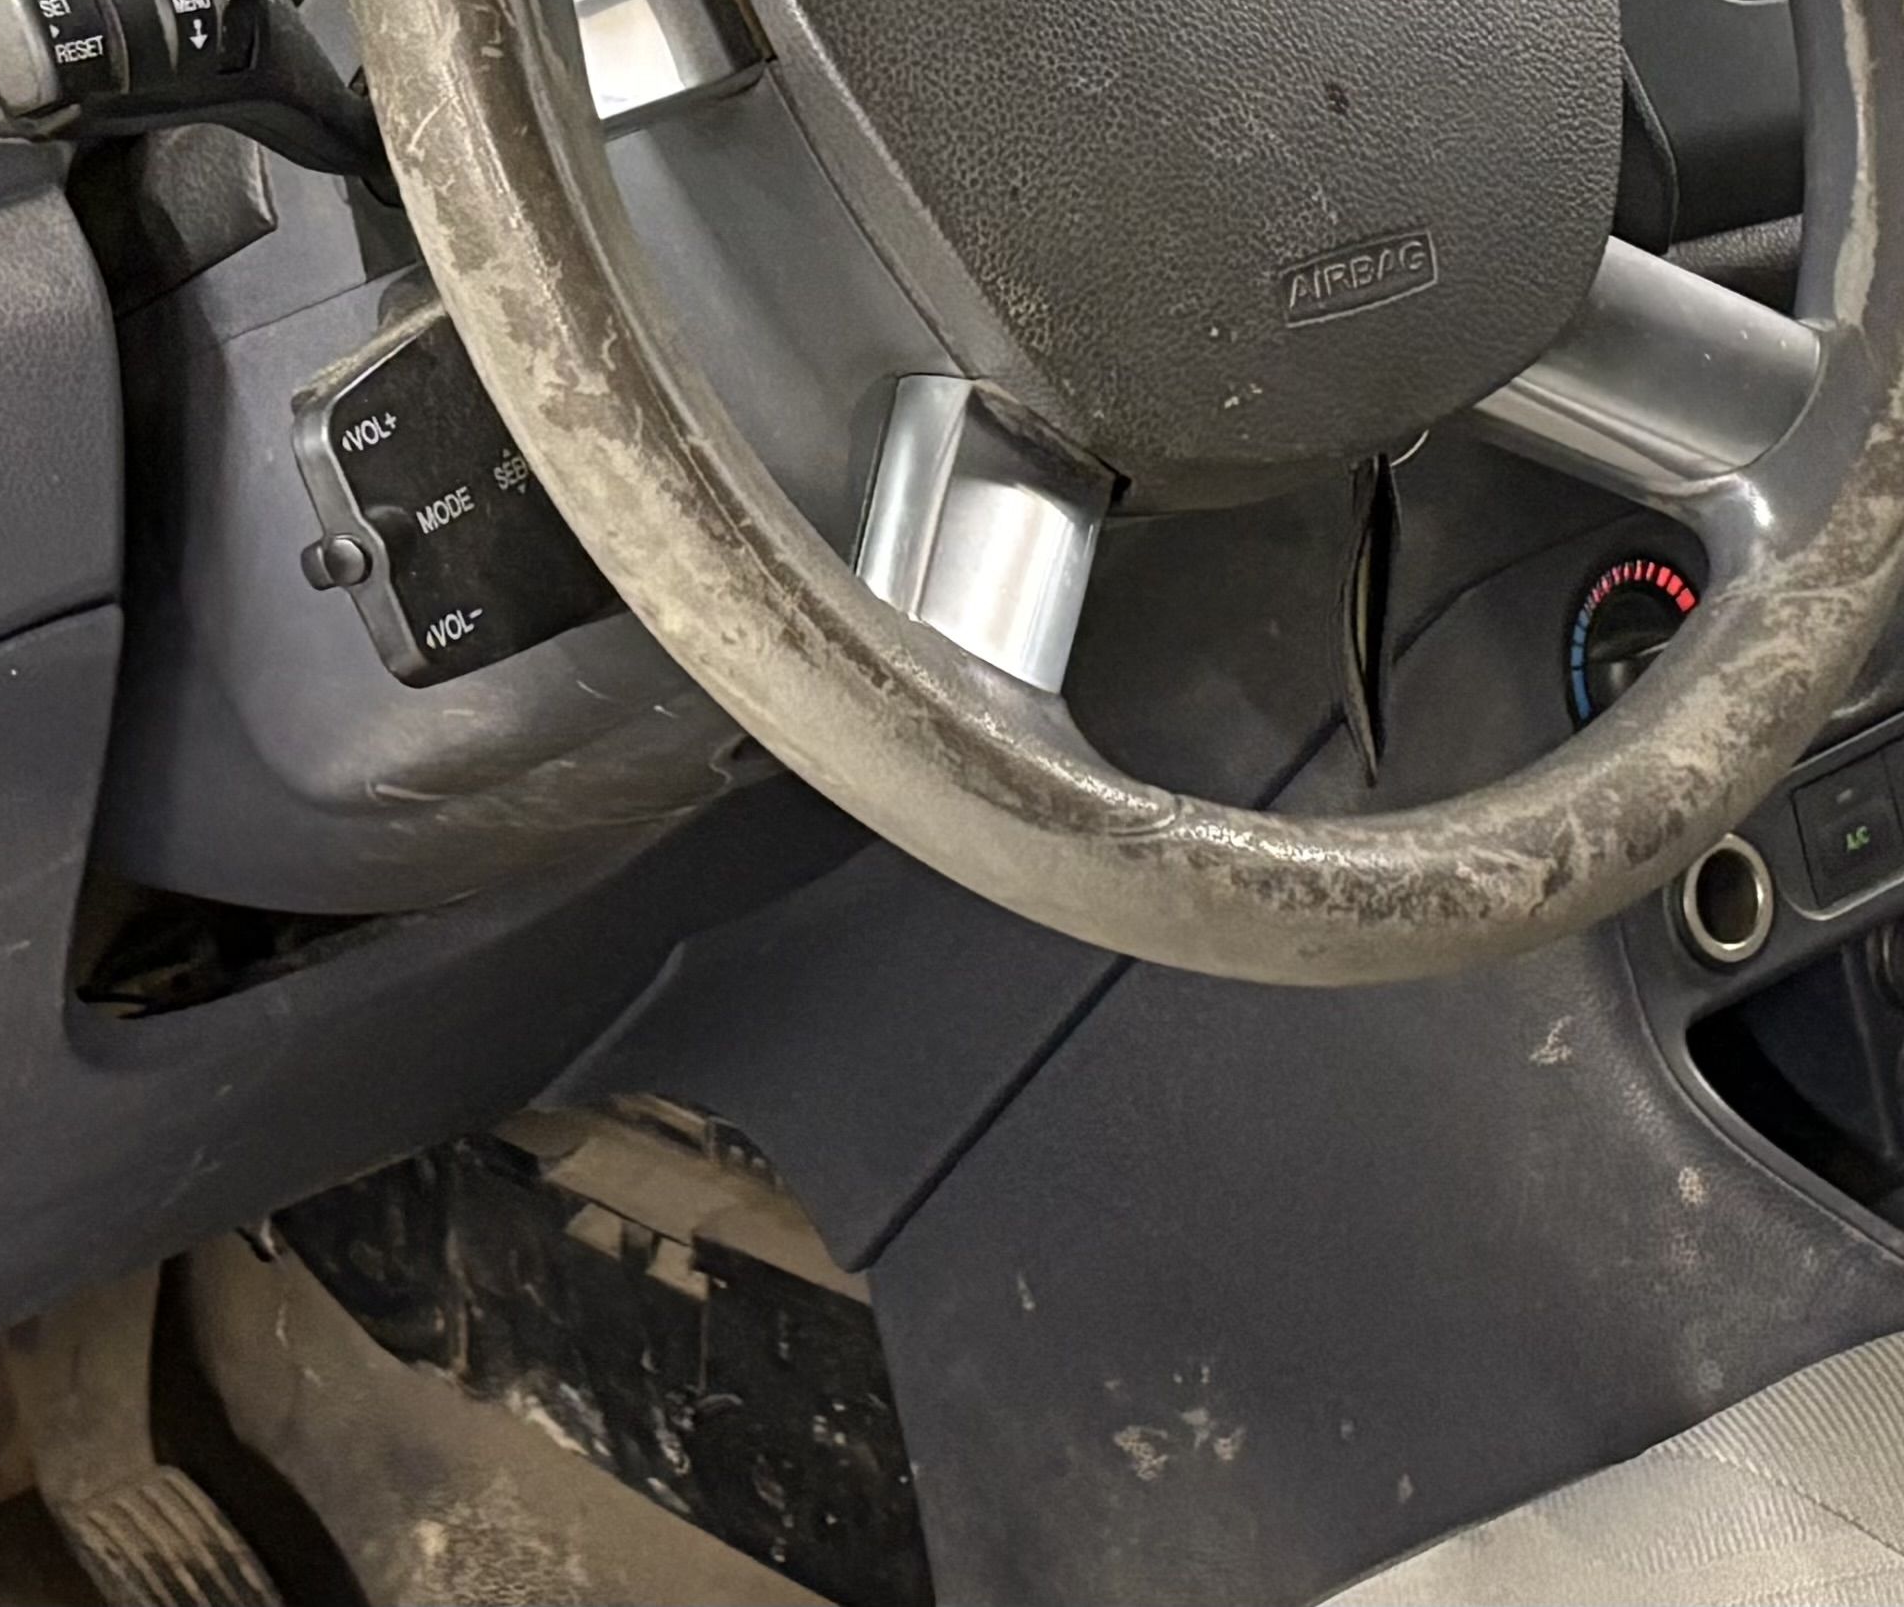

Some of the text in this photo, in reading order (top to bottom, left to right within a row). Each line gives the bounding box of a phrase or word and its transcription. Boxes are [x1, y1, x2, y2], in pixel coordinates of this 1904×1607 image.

[54, 35, 105, 64] RESET
[1288, 239, 1428, 310] AIRBAG
[347, 411, 398, 451] VOL+
[415, 485, 476, 535] MODE
[431, 607, 484, 649] VOL-
